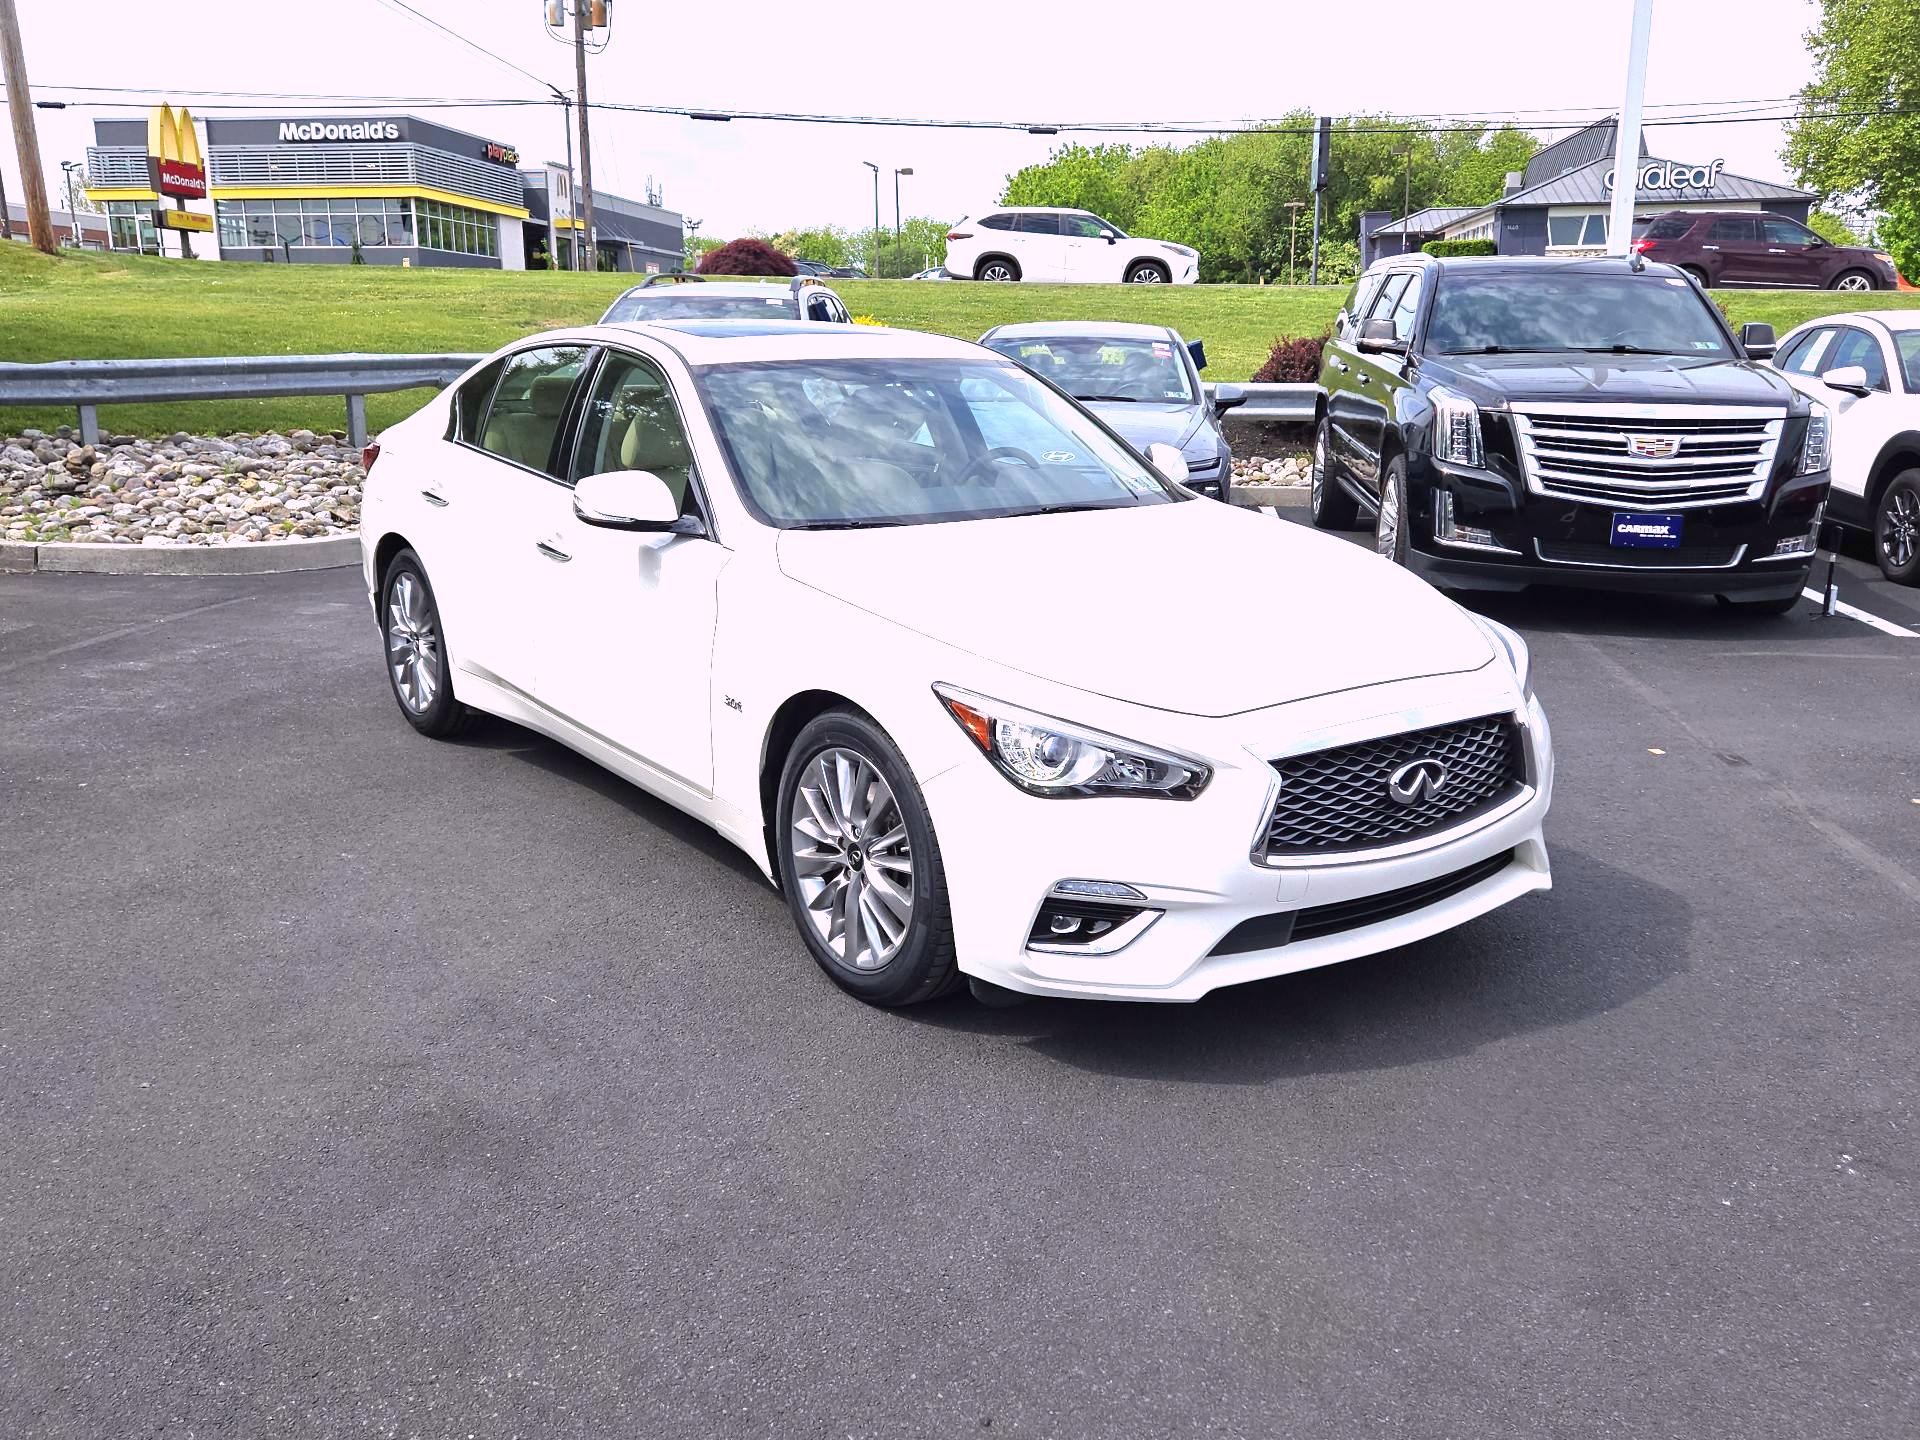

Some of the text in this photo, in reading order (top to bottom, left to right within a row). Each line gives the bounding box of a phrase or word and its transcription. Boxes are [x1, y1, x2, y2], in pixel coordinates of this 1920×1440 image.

[278, 120, 401, 142] McDonald's
[162, 172, 206, 190] McDonald's
[1603, 158, 1725, 191] craleaf
